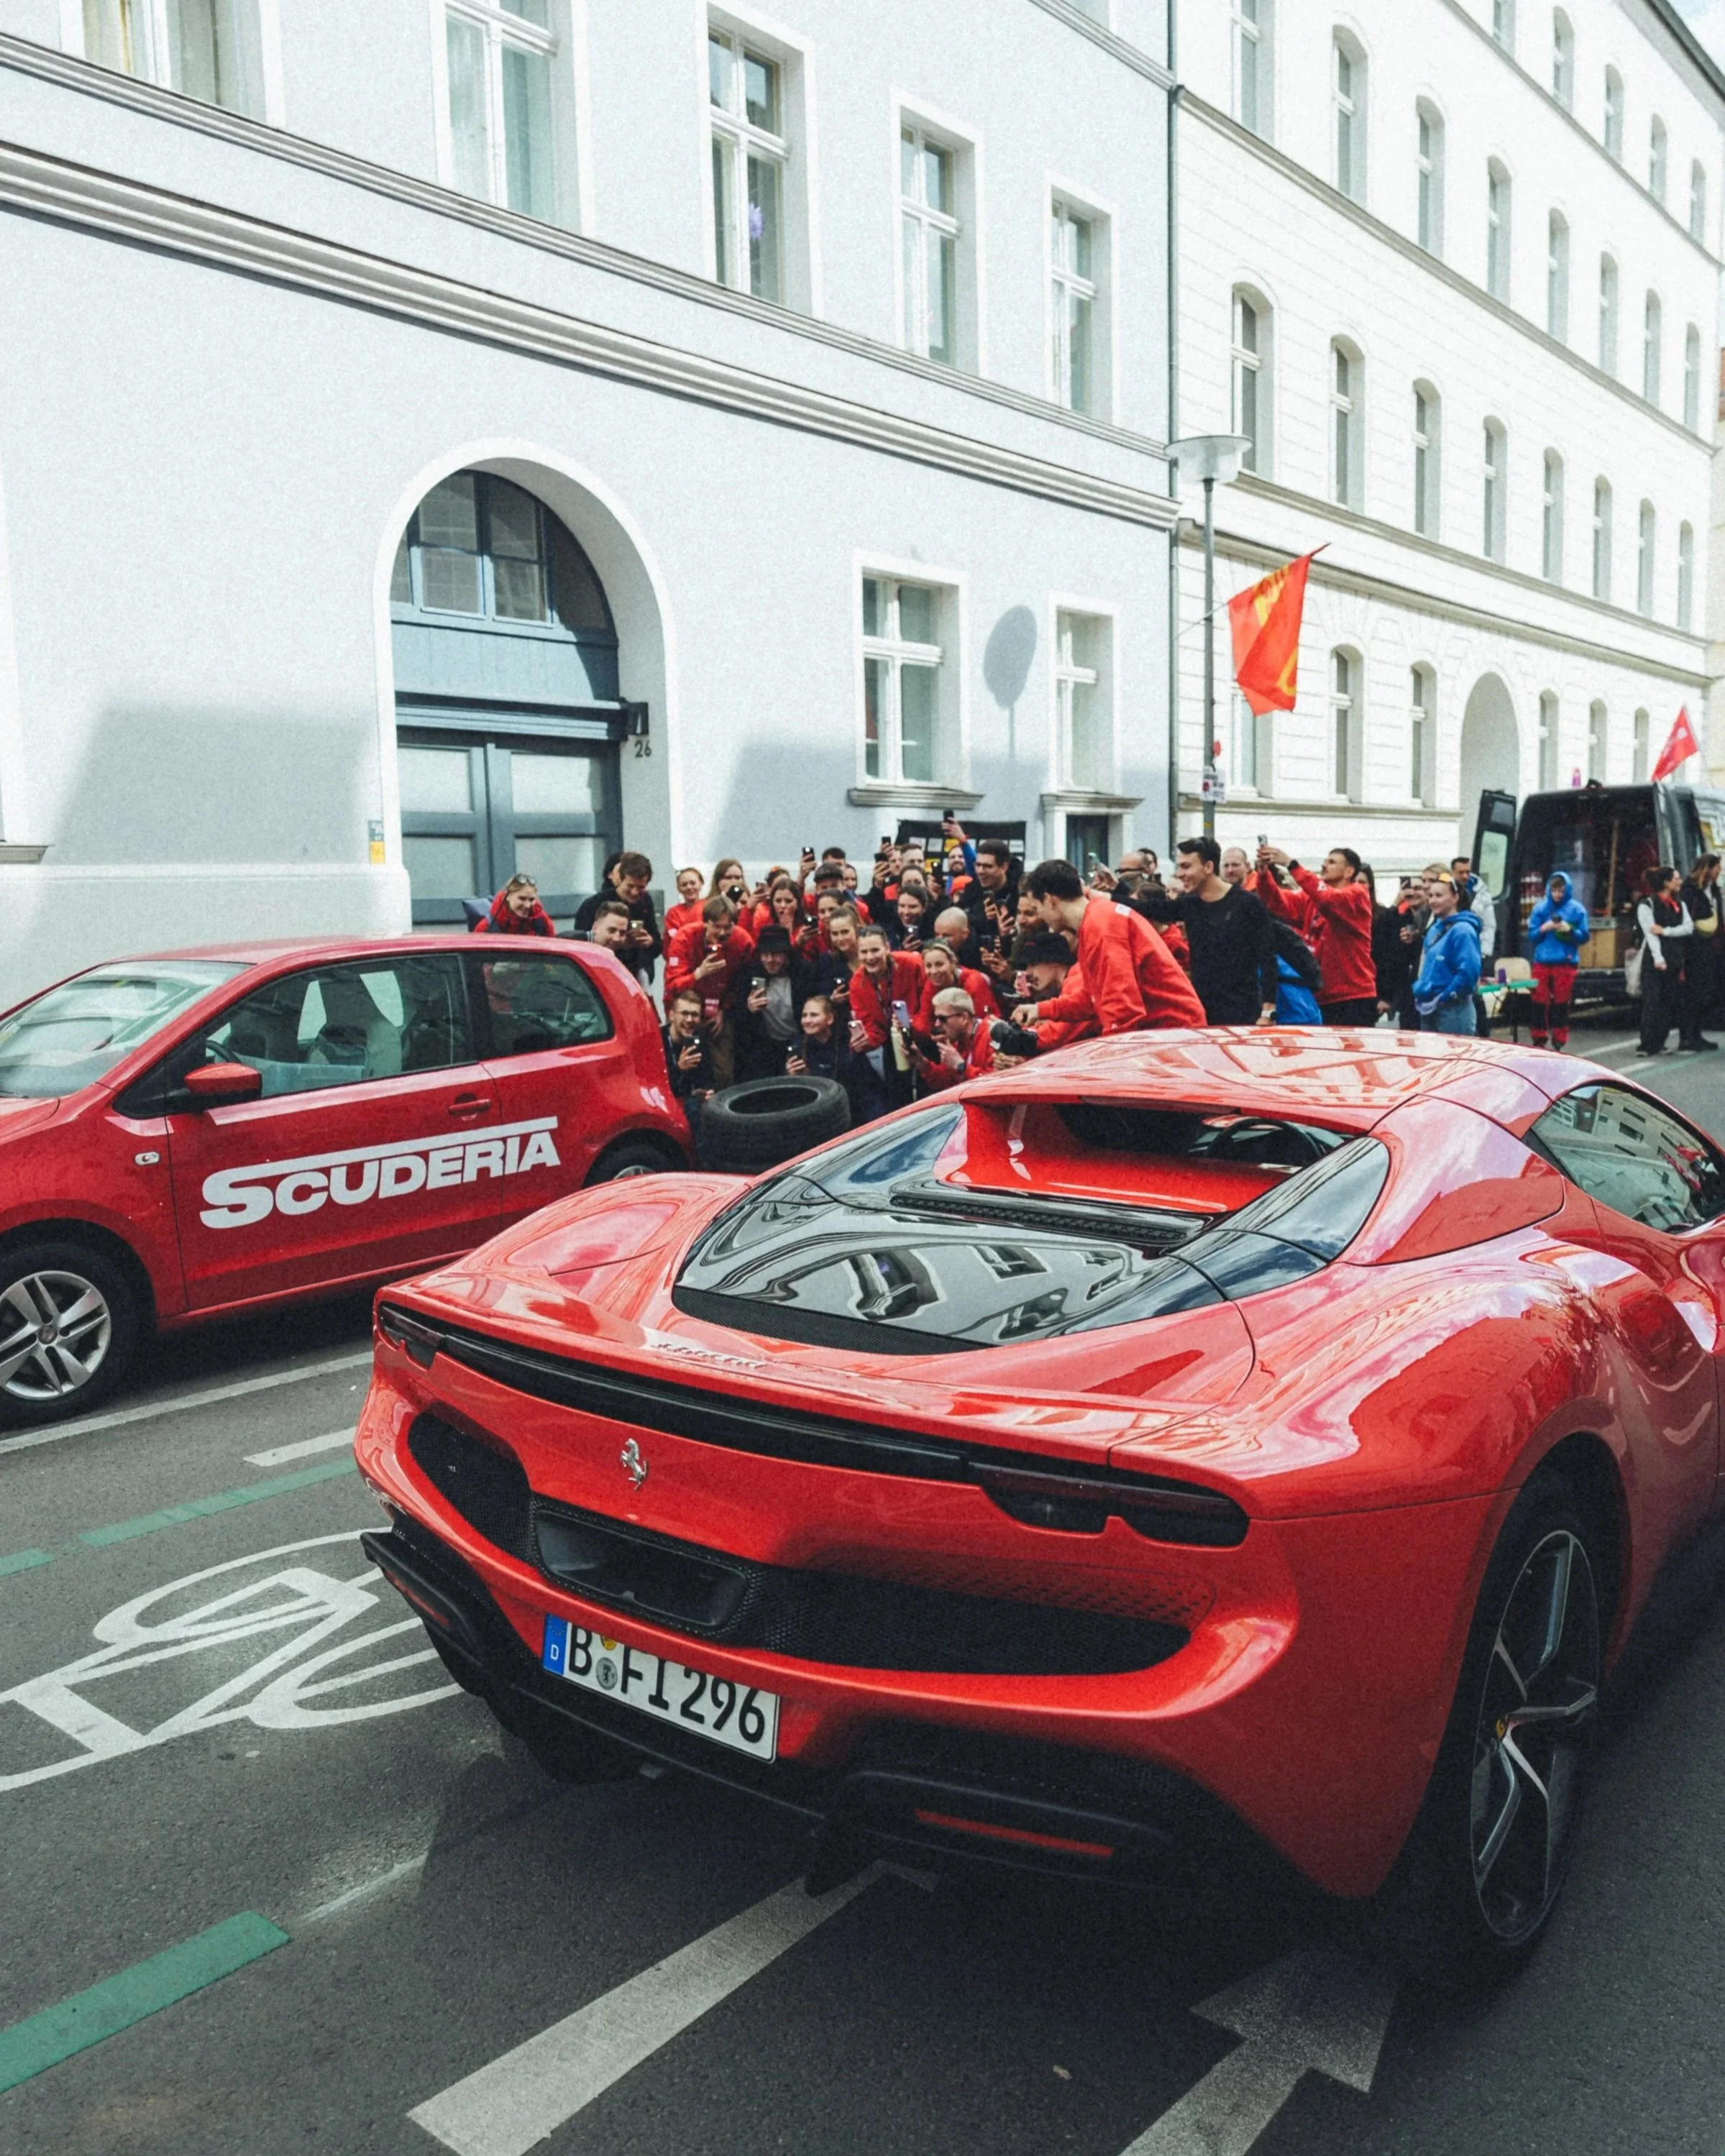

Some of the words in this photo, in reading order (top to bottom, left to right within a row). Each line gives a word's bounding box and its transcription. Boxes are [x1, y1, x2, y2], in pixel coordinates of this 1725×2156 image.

[634, 740, 652, 758] 26
[200, 1116, 561, 1229] SCUDERIA
[550, 1644, 559, 1661] D
[569, 1627, 592, 1676] B
[680, 1669, 766, 1743] 296
